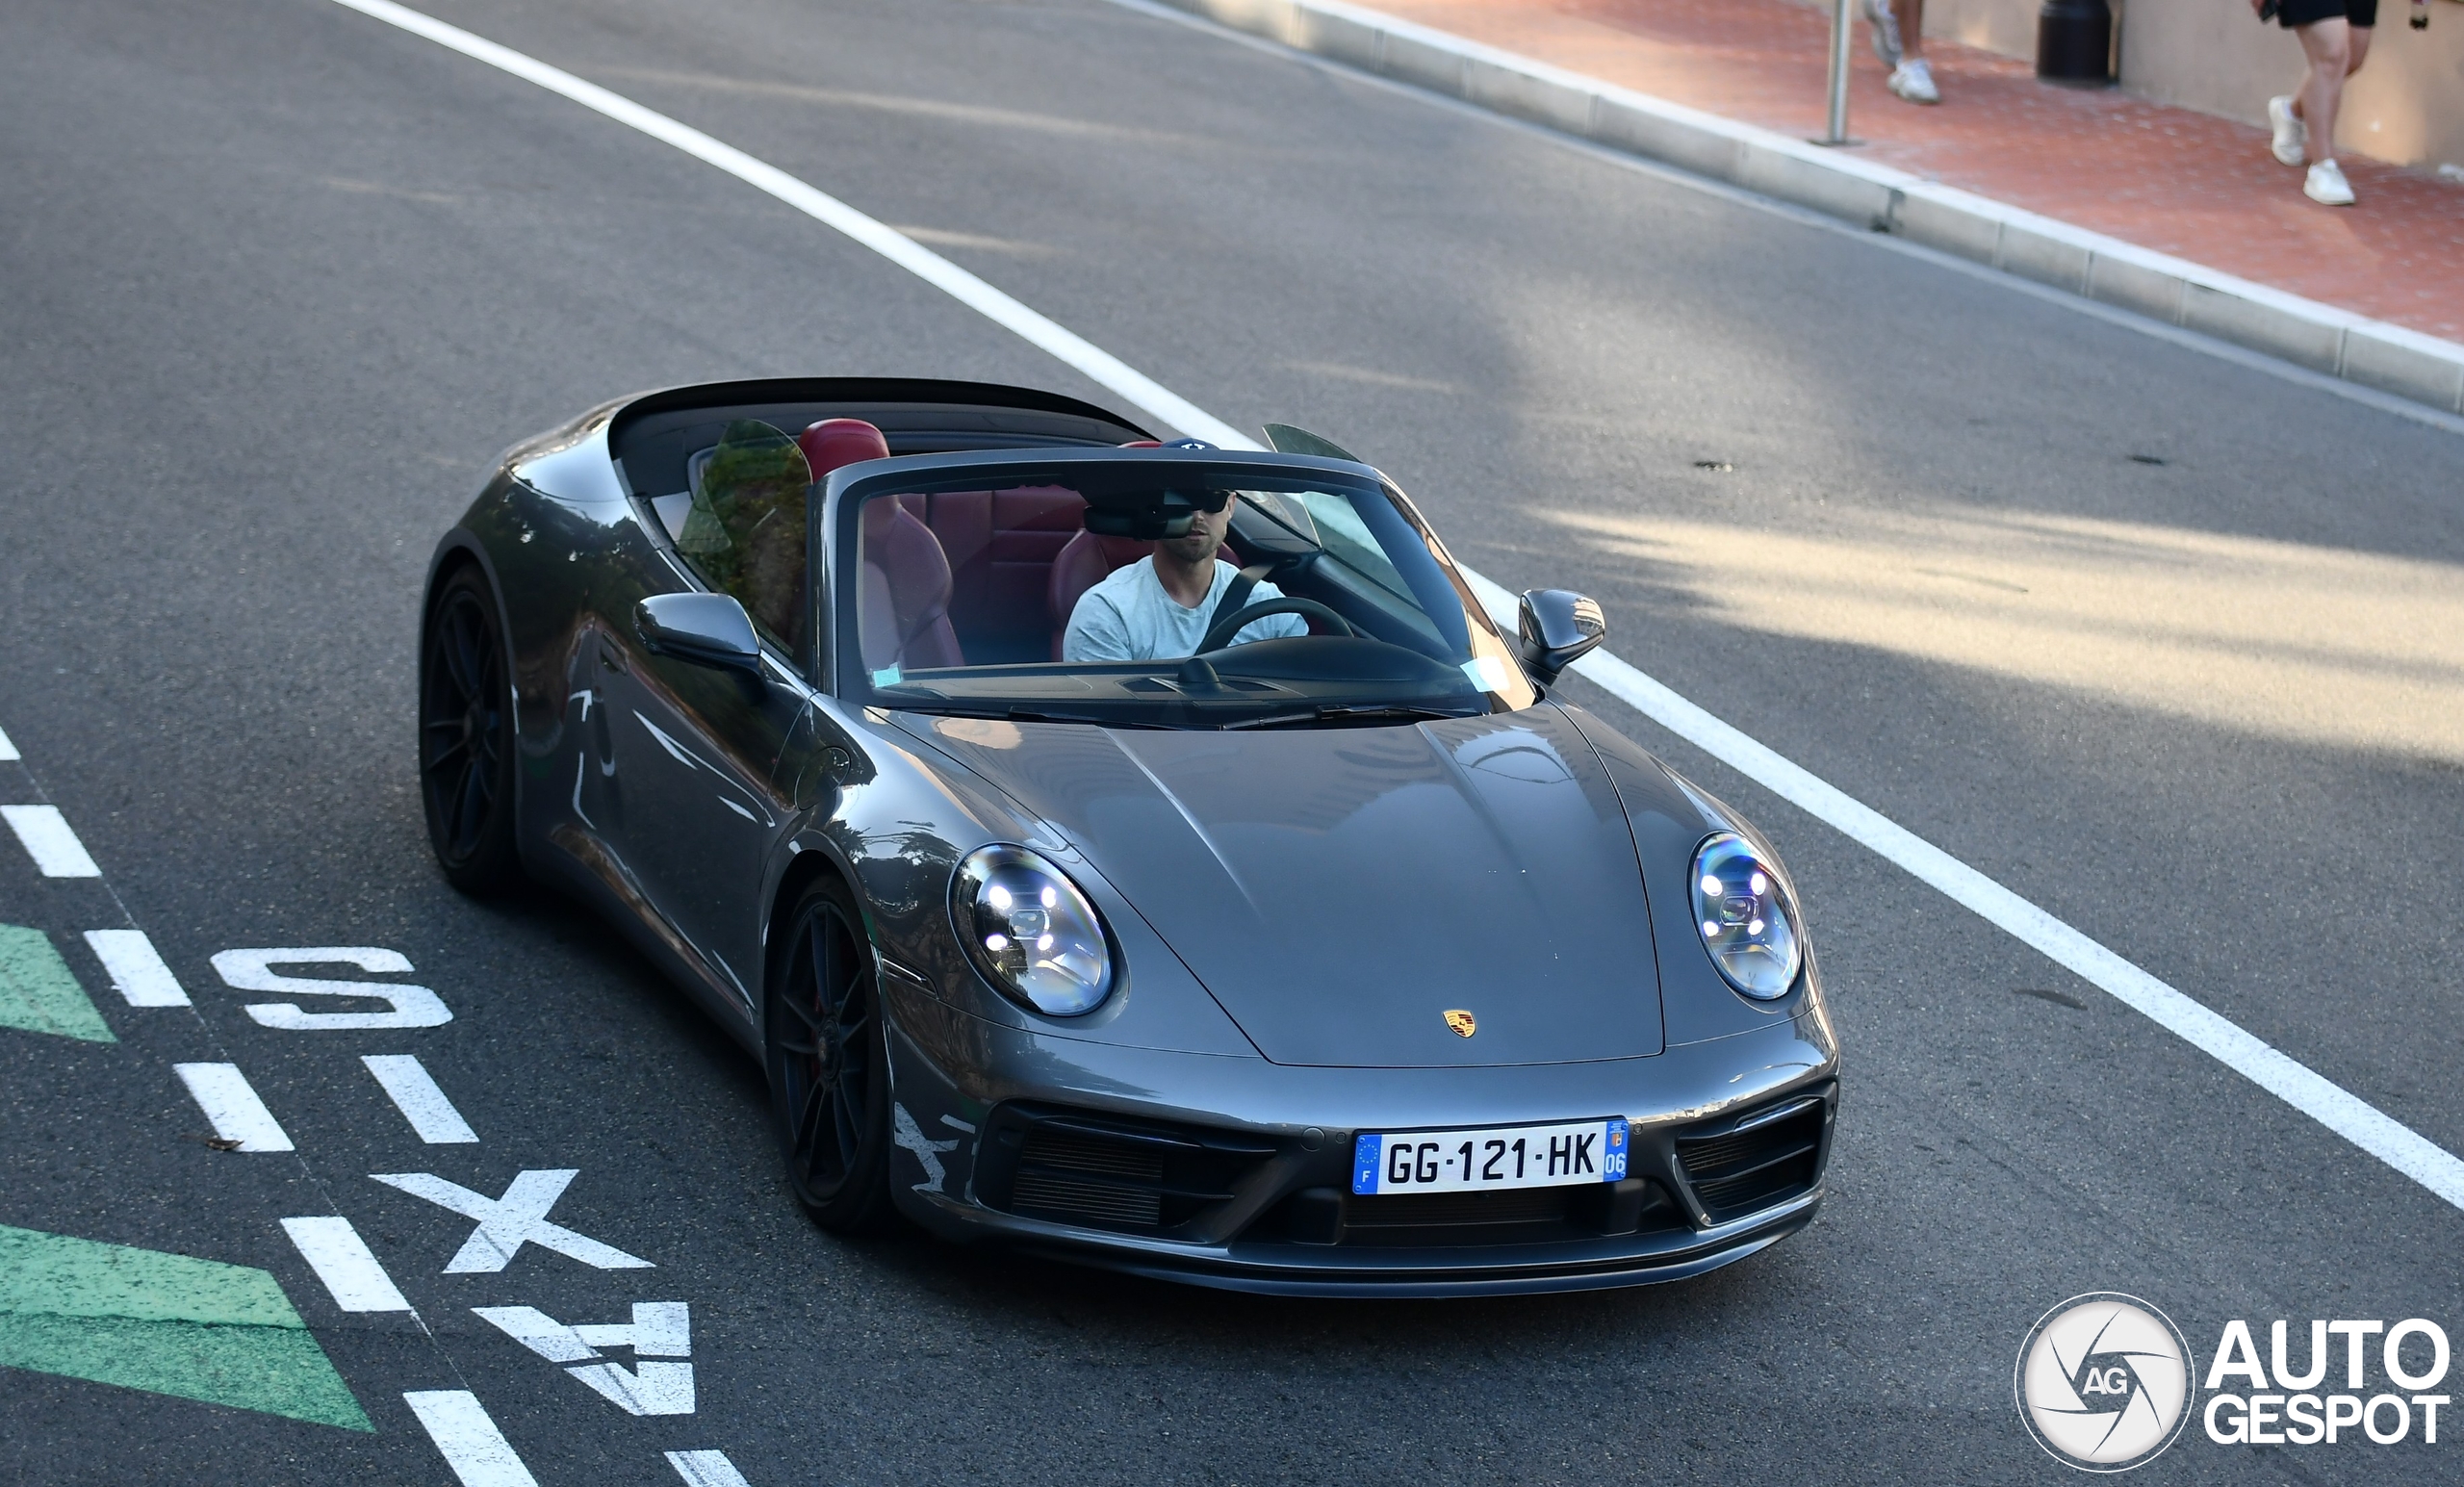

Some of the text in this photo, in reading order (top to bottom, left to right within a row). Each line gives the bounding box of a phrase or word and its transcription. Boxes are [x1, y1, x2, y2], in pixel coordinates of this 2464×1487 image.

[1387, 1133, 1597, 1184] GG-121-HK
[1605, 1153, 1626, 1174] 06
[1362, 1170, 1371, 1183] F
